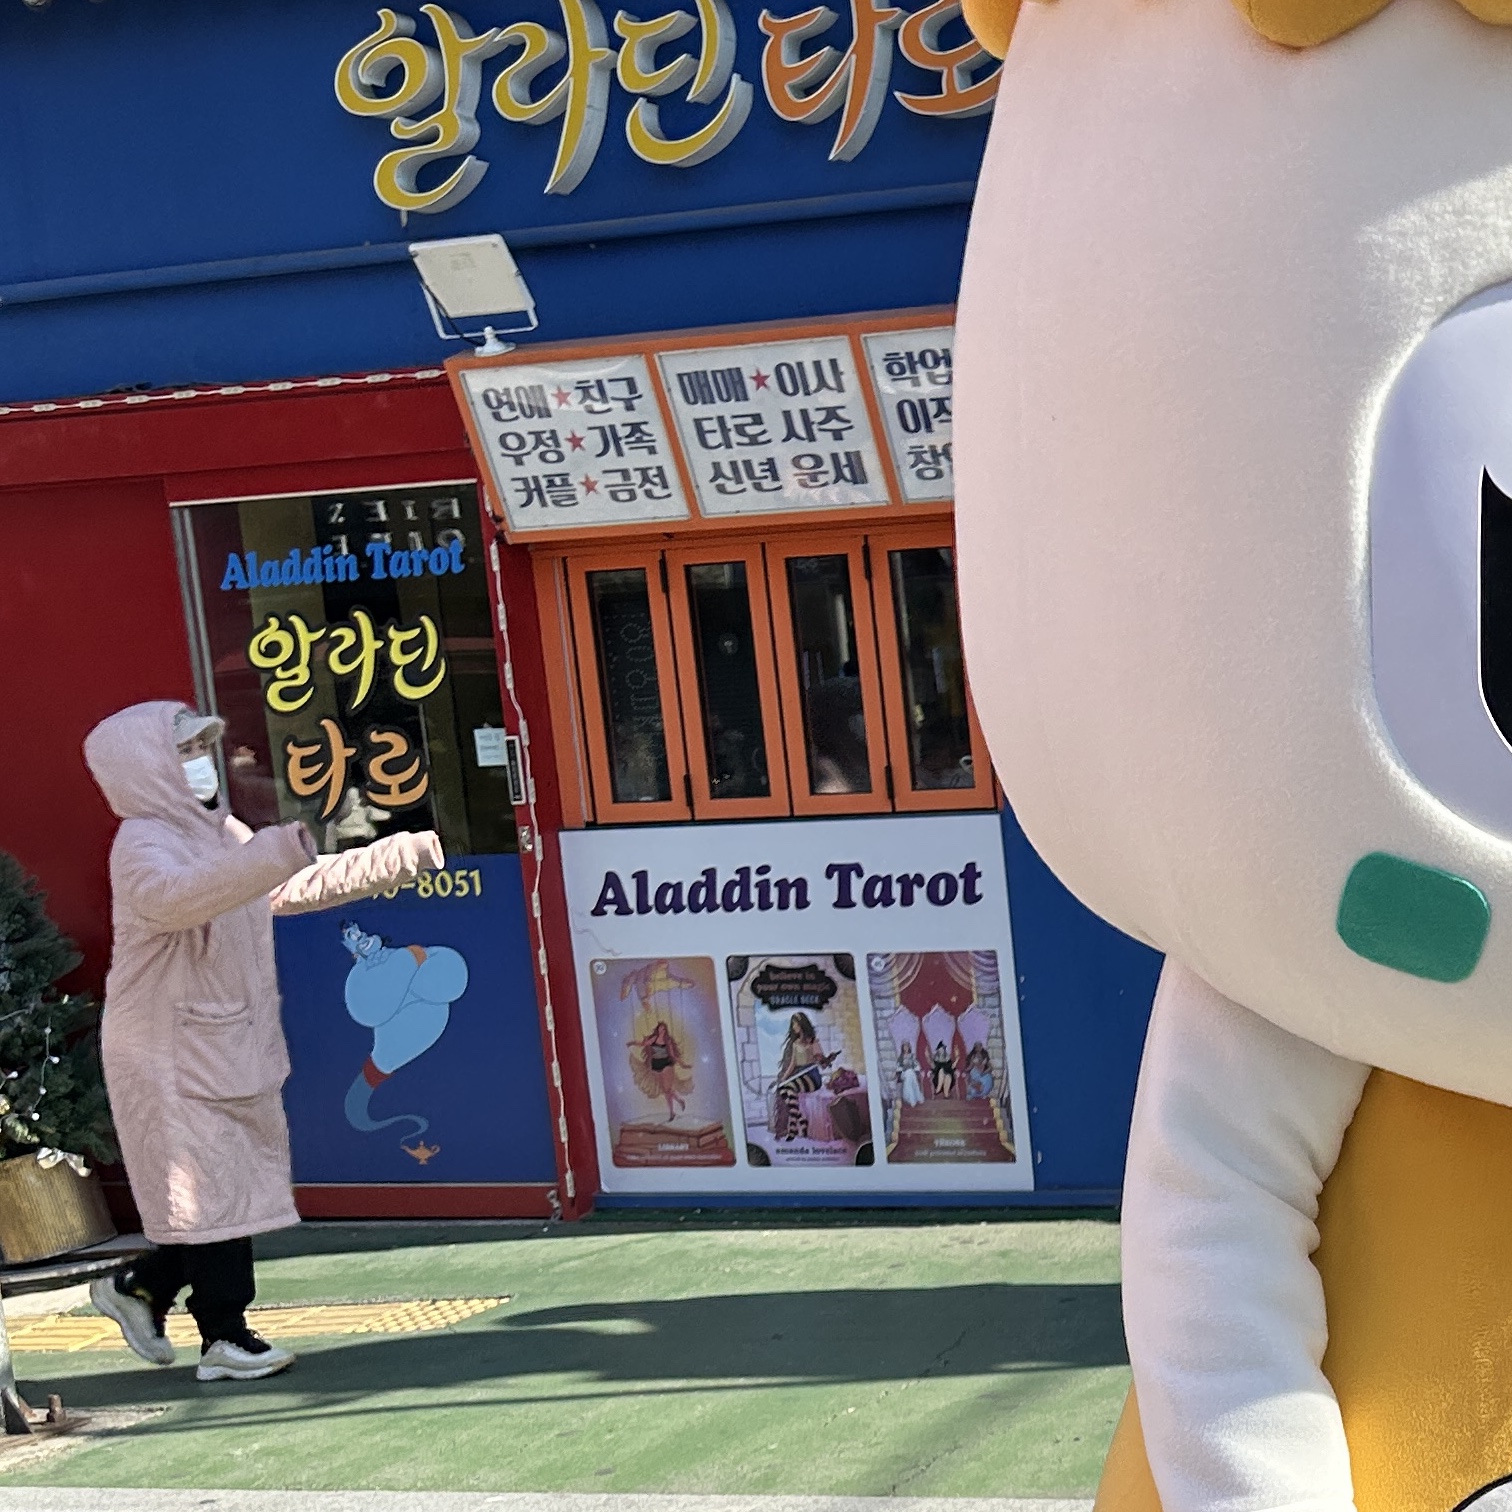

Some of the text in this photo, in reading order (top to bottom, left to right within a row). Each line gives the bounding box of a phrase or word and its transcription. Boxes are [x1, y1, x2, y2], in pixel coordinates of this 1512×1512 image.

[335, 0, 753, 211] 알라딘
[483, 376, 643, 422] 연애 친구
[676, 359, 845, 405] 매매 이사
[500, 420, 658, 466] 우정 가족
[694, 405, 855, 450] 타로 사주
[708, 450, 868, 495] 신년 운세
[906, 443, 952, 480] 창
[512, 465, 672, 509] 커플 금전
[221, 544, 360, 590] Aladdin
[366, 537, 466, 580] Tarot
[248, 610, 447, 713] 알라딘
[286, 718, 430, 819] 타로
[372, 868, 482, 900] -8051
[591, 861, 983, 917] Aladdin Tarot
